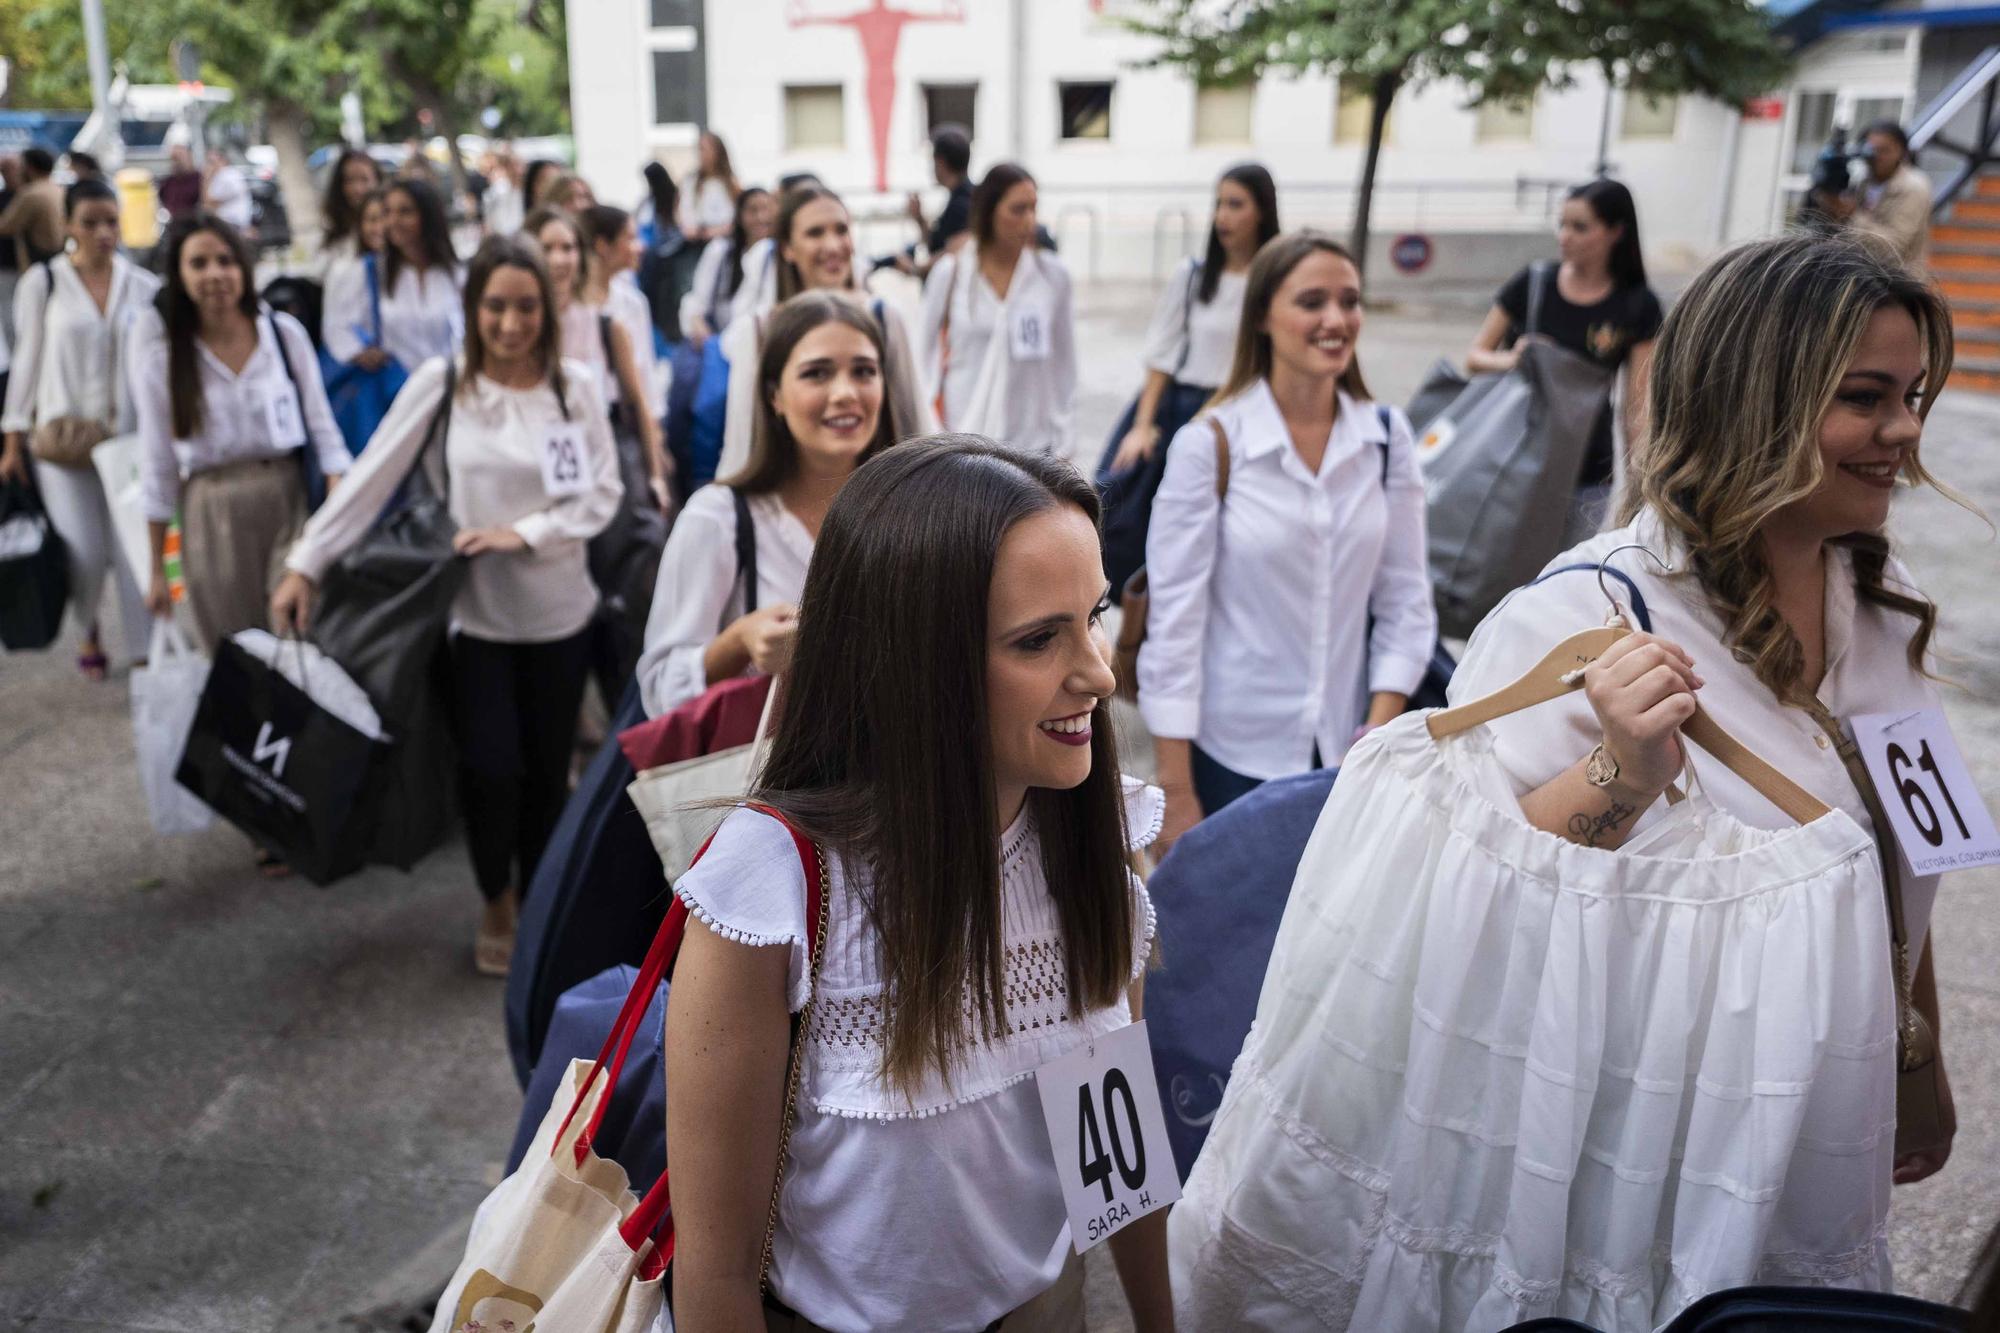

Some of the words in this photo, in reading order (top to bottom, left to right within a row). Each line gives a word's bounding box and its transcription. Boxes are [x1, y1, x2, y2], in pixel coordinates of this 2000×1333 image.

[548, 438, 578, 480] 29
[1886, 738, 1971, 847] 61
[1079, 1068, 1146, 1203] 40
[1088, 1203, 1131, 1241] SARA
[1140, 1191, 1157, 1209] H.
